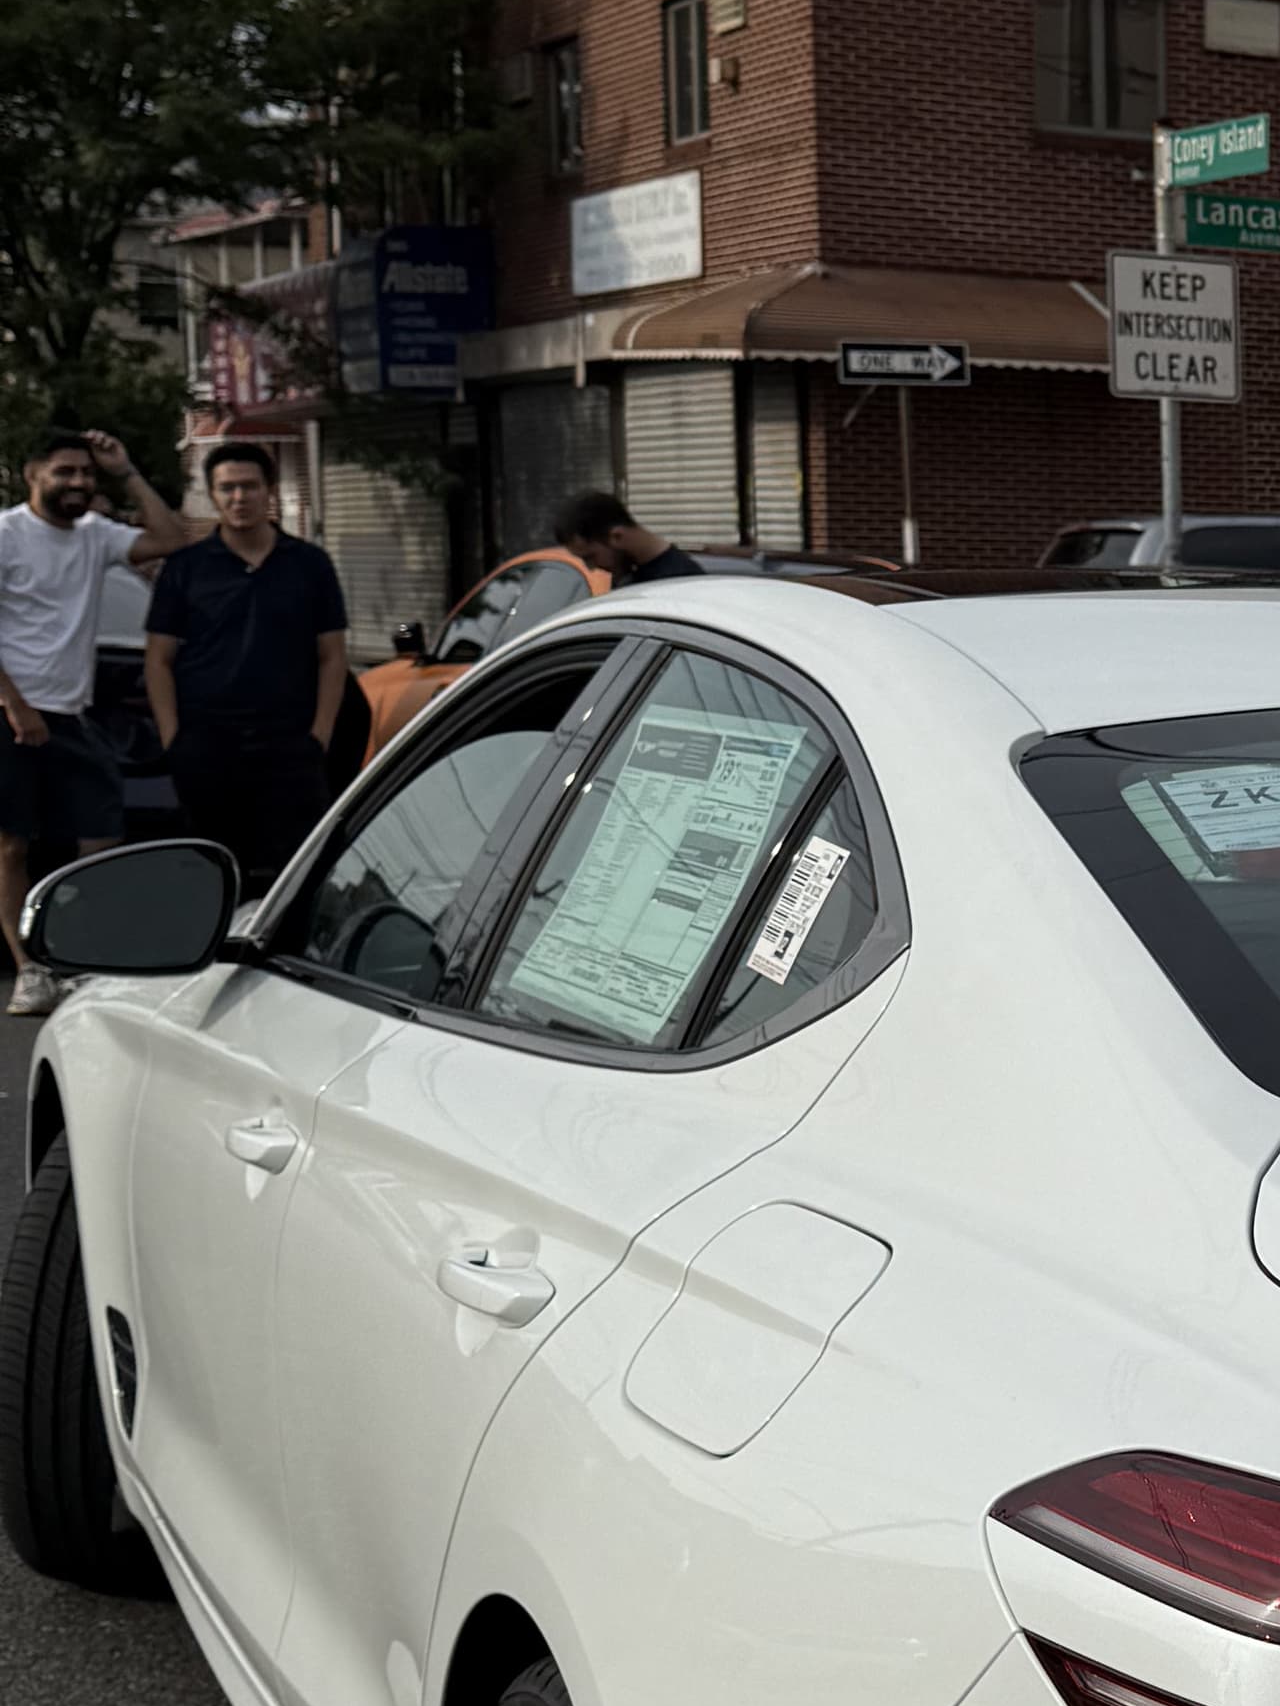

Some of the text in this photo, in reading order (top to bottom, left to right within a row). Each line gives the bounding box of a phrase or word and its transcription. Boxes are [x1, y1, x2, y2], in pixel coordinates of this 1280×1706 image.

[1174, 117, 1265, 166] Coney Island
[1141, 270, 1206, 304] KEEP
[1117, 303, 1233, 344] INTERSECTION
[859, 354, 948, 372] ONE WAY
[1134, 352, 1218, 385] CLEAR
